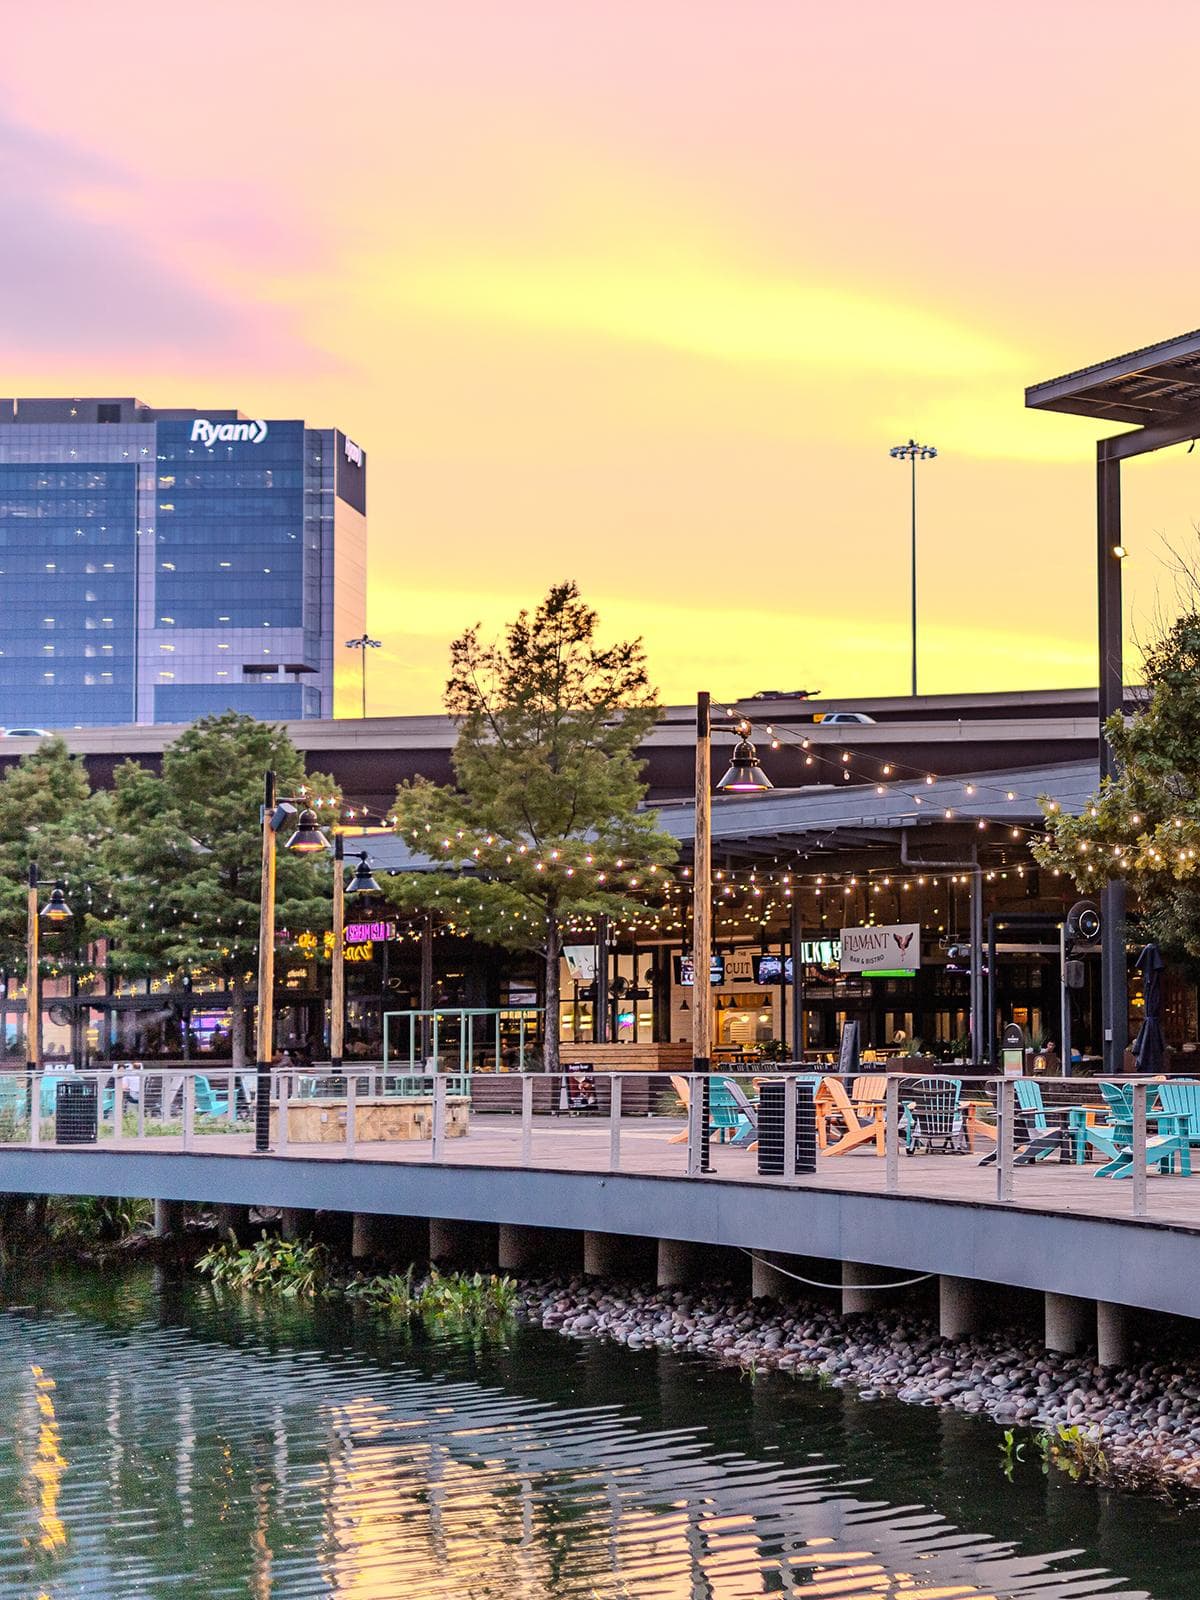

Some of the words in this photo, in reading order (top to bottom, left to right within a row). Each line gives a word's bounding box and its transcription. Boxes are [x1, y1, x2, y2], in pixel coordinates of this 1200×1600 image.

[190, 419, 249, 447] Ryan
[844, 932, 890, 952] FLAMANT
[865, 954, 885, 964] BISTRO
[725, 962, 751, 974] CUIT
